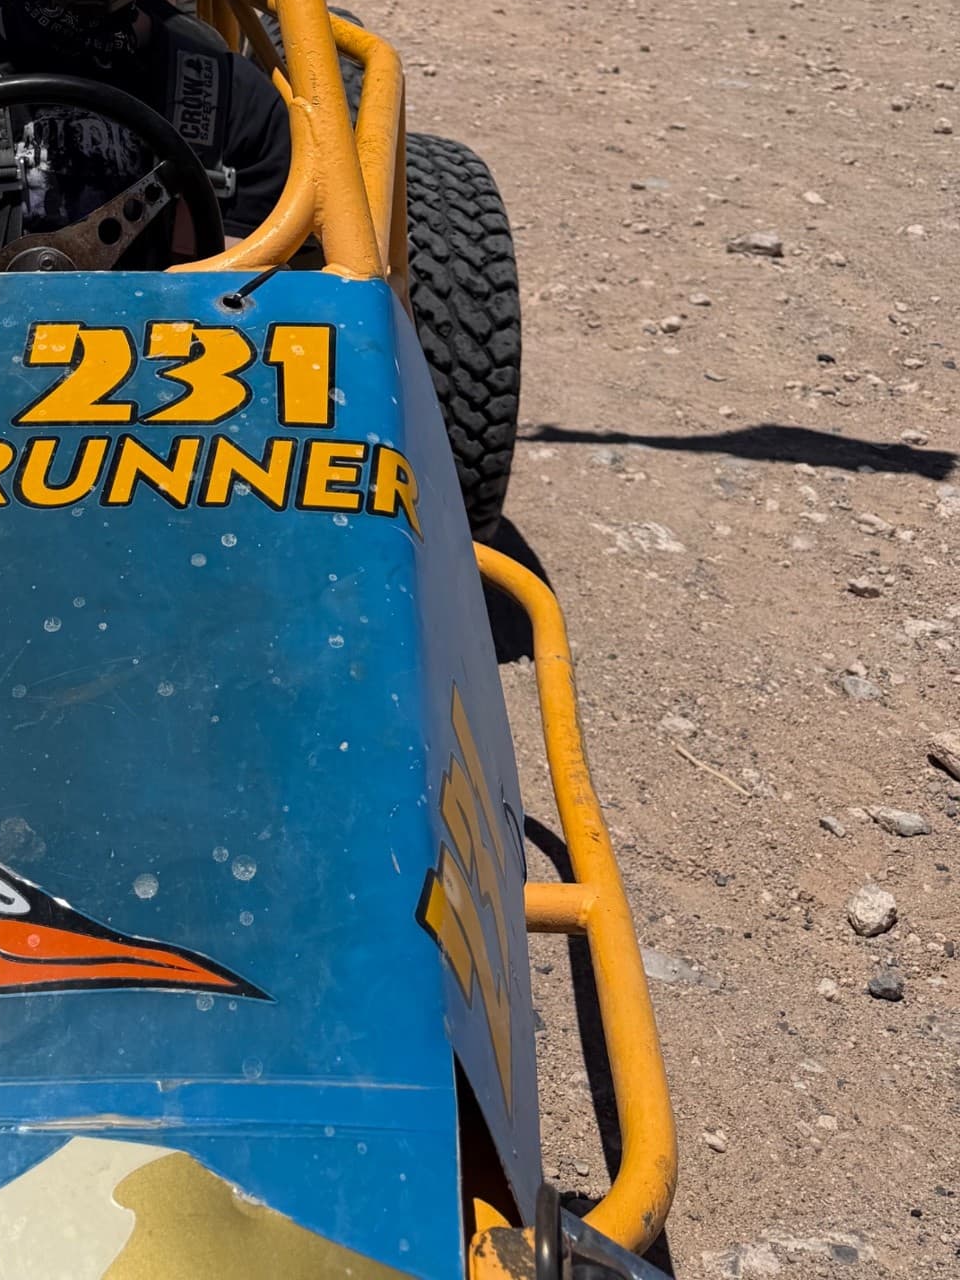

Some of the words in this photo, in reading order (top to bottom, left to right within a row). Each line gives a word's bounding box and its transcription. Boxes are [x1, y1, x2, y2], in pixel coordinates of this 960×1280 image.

[180, 75, 203, 139] CROW
[200, 91, 213, 140] SAFETY
[11, 320, 338, 428] 231
